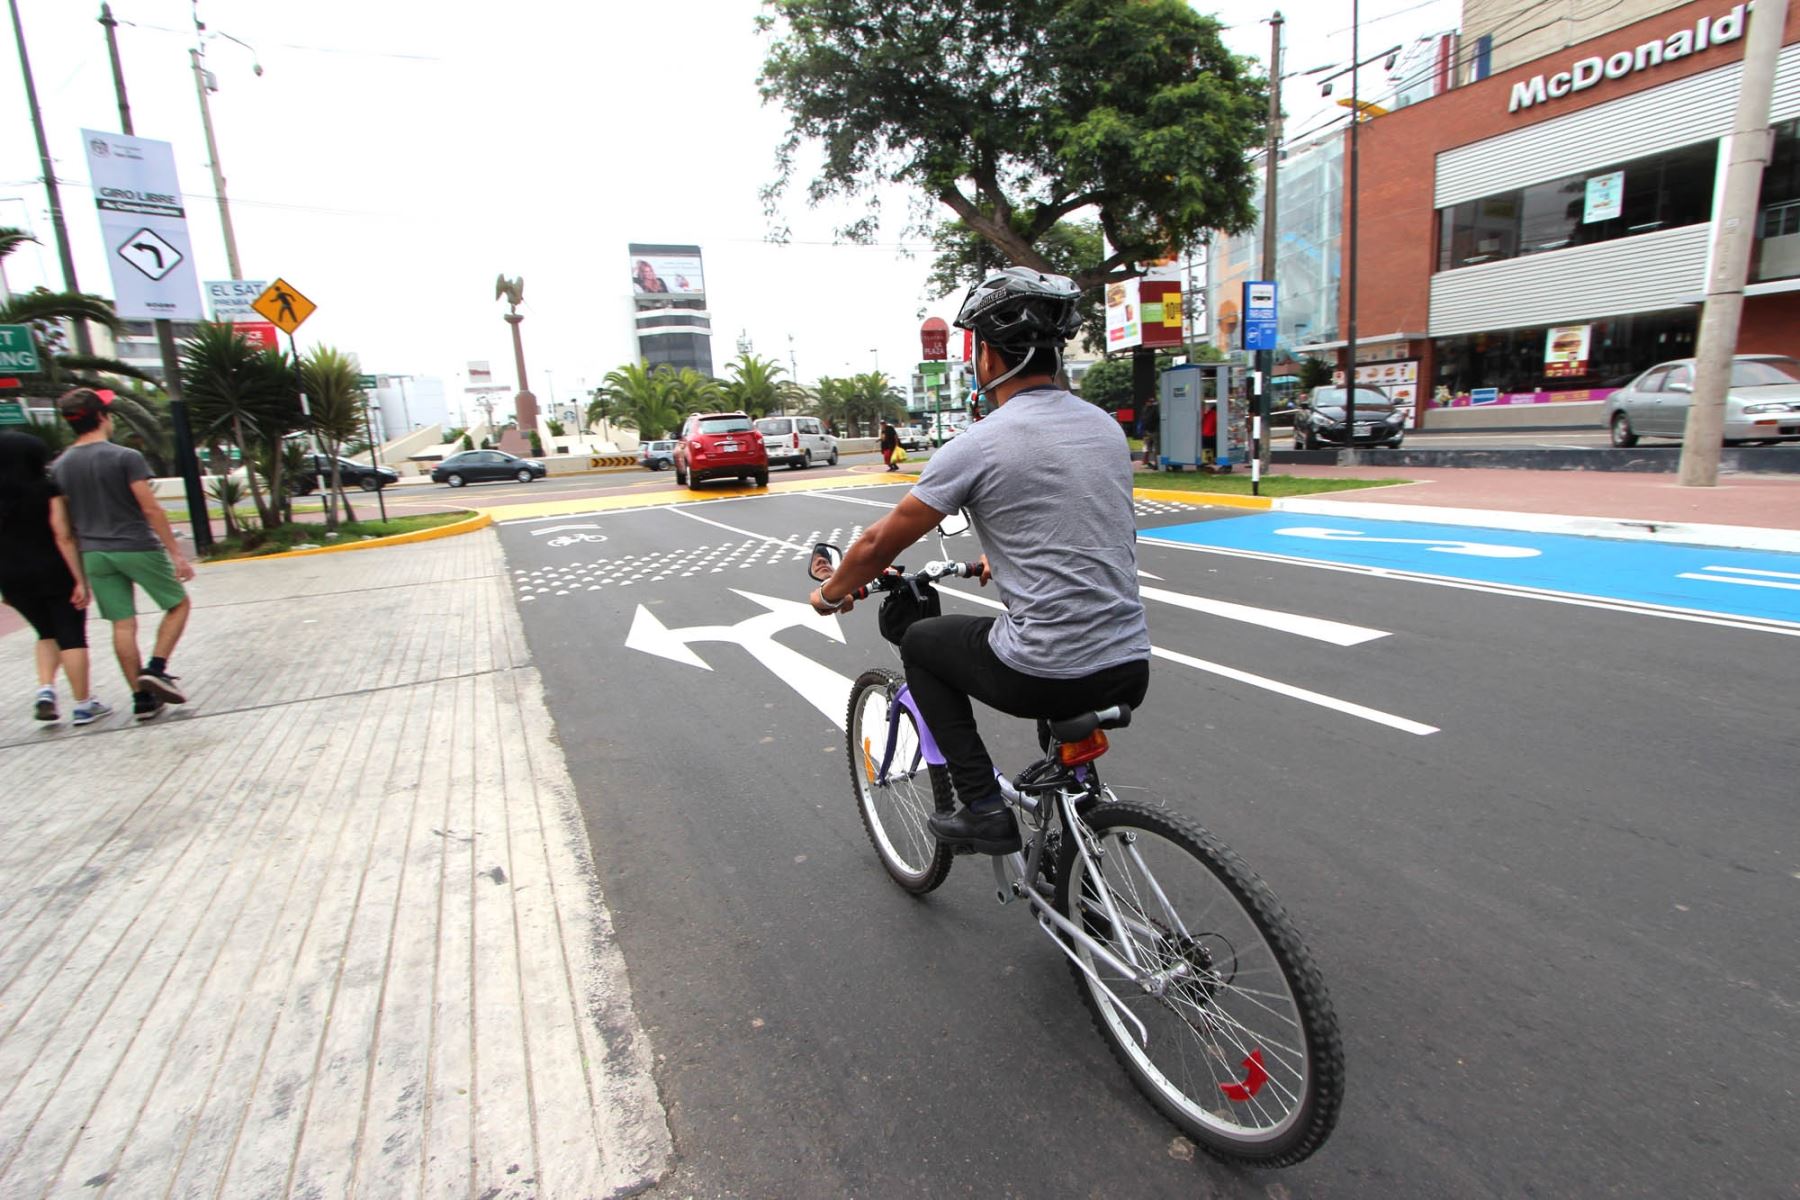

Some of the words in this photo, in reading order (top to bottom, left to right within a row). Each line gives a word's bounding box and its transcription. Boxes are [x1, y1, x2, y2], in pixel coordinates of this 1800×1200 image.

[1508, 0, 1757, 113] McDonald'
[100, 187, 134, 200] GIRO
[137, 191, 177, 205] LIBRE
[211, 284, 230, 297] EL
[233, 284, 263, 297] SAT
